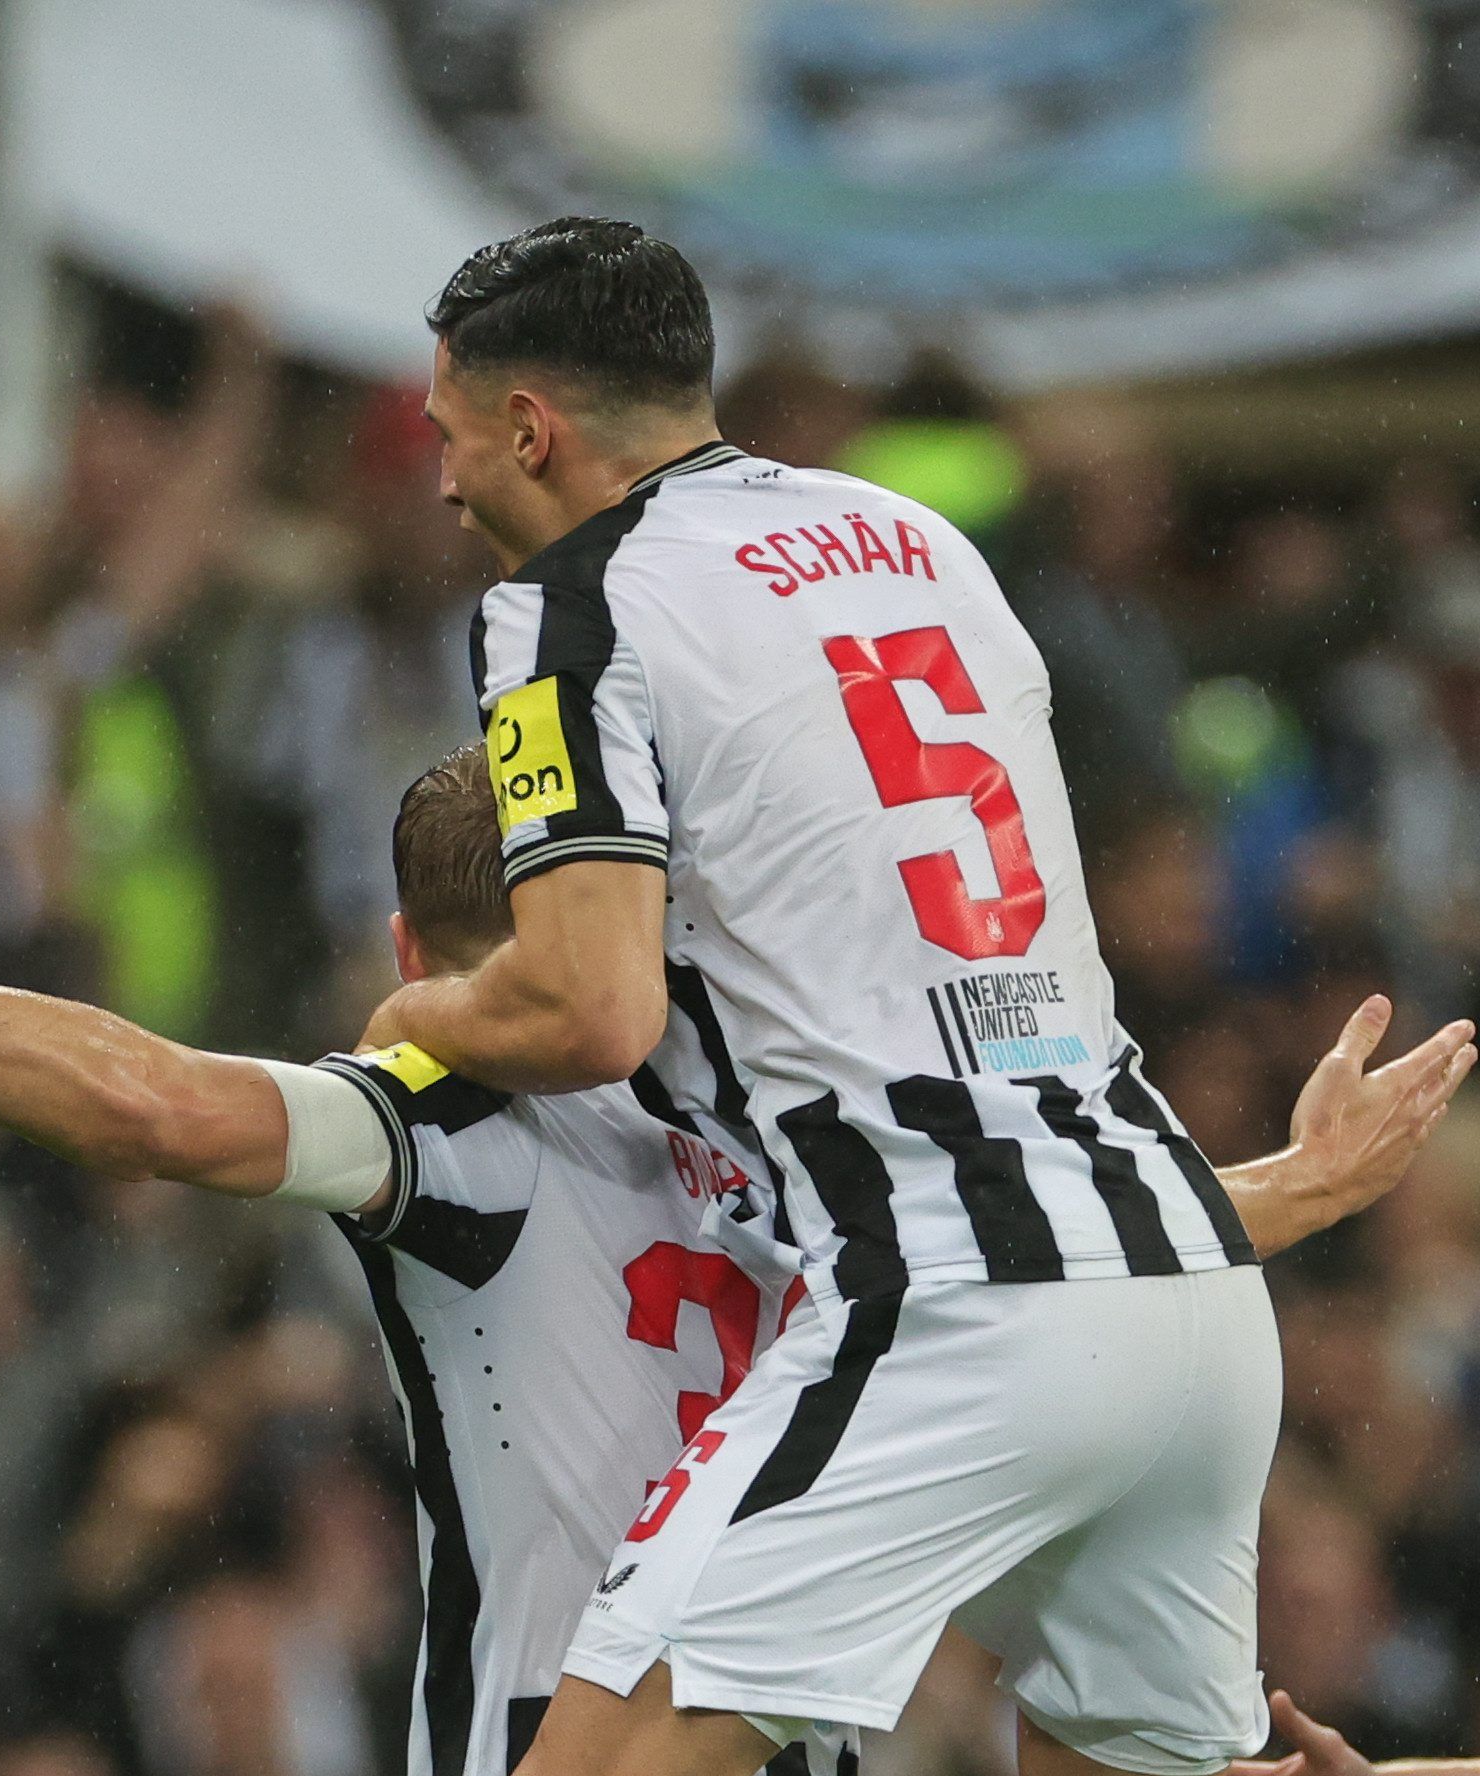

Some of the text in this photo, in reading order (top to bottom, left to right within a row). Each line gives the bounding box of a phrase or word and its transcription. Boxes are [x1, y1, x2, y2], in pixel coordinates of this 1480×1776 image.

[734, 512, 938, 597] SCHÄR
[820, 624, 1047, 962] 5
[960, 971, 1065, 1009] NEWCASTLE
[969, 1005, 1039, 1042] UNITED
[976, 1034, 1092, 1074] FOUNDATION
